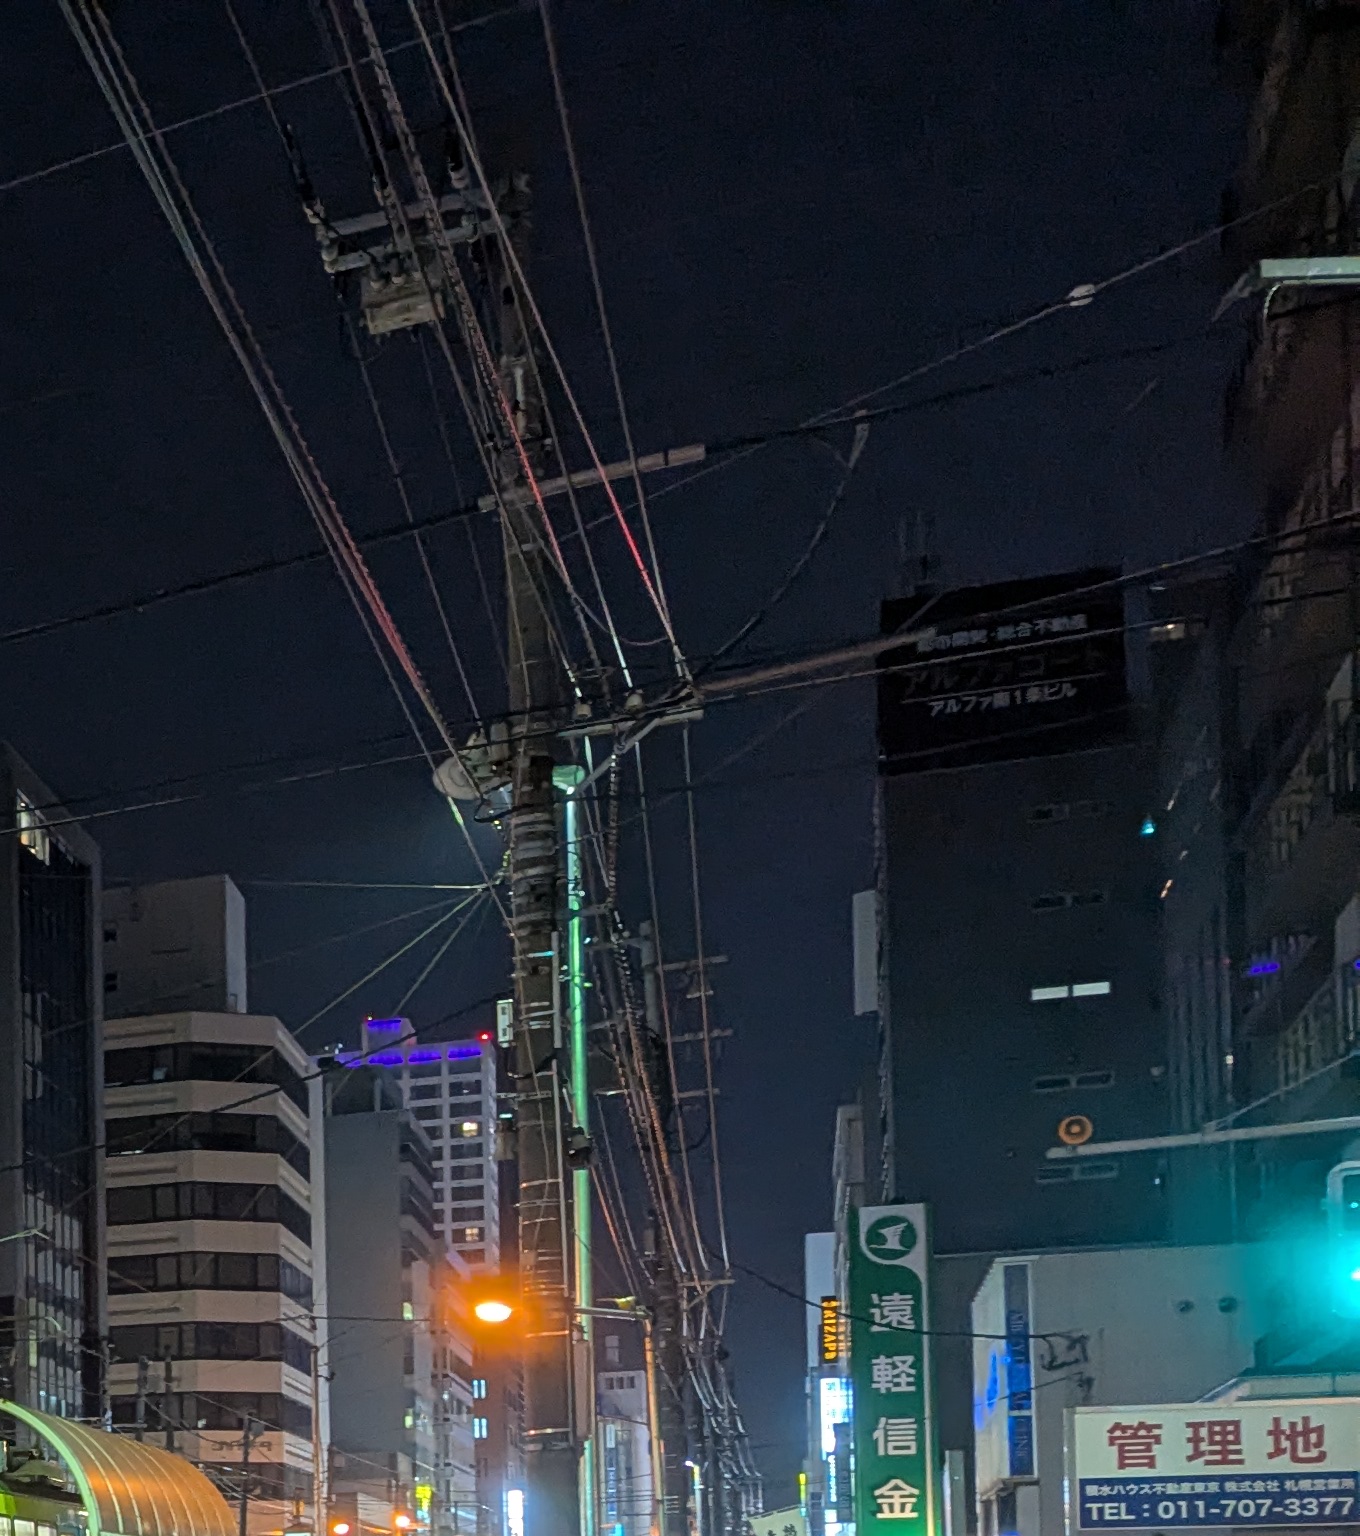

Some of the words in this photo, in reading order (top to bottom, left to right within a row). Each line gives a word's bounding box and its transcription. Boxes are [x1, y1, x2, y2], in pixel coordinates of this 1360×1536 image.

[869, 1292, 921, 1519] 遠軽信金
[1107, 1416, 1328, 1470] 管理地
[1224, 1480, 1280, 1493] 株式会社
